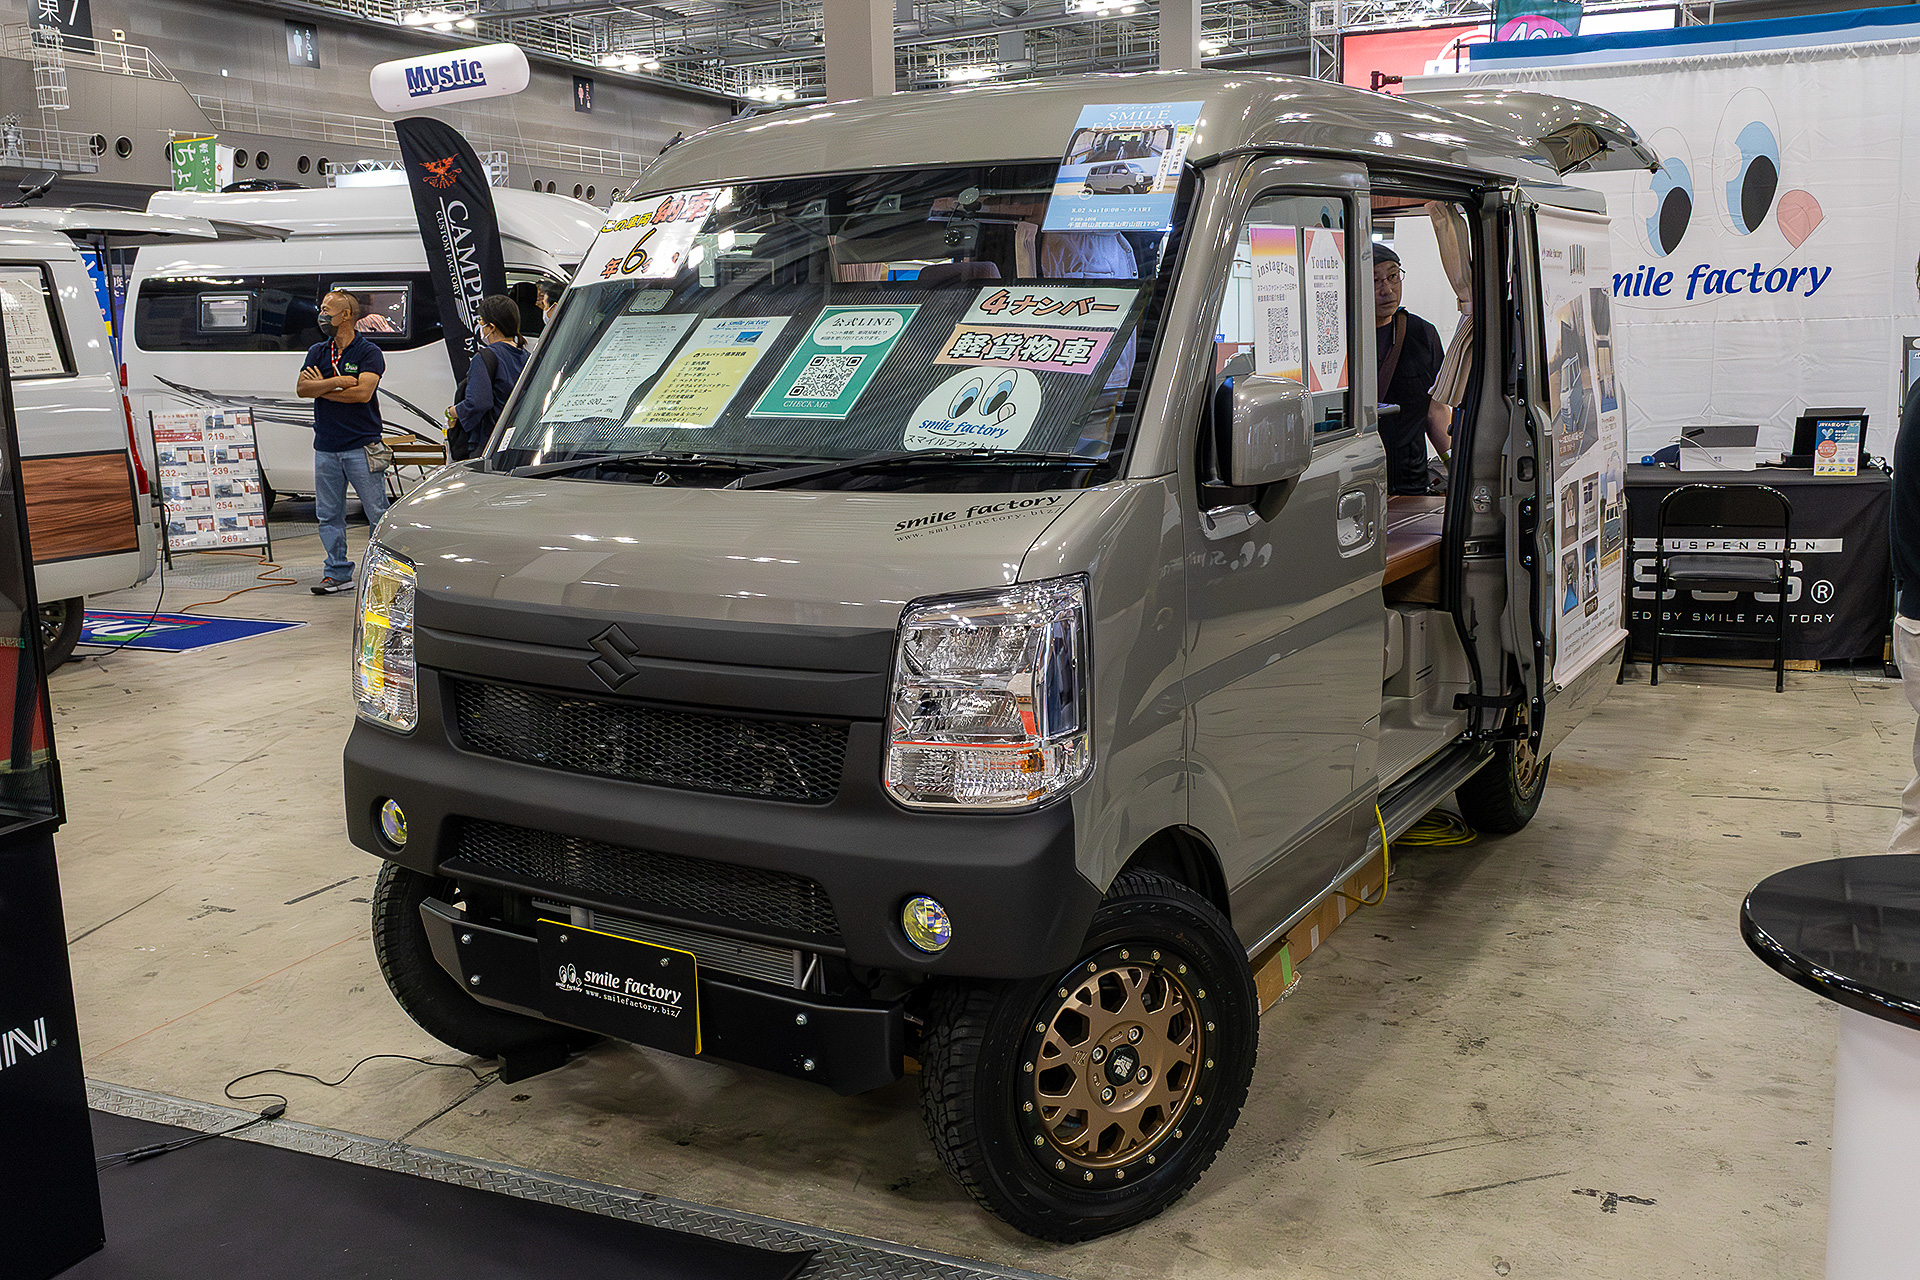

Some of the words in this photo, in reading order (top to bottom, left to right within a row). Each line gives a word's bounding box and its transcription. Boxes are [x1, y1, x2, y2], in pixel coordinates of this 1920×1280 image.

[405, 59, 486, 93] Mystic
[1091, 119, 1180, 132] FACTORY
[1107, 110, 1170, 121] SMILE
[435, 210, 450, 252] CUSTOM
[446, 253, 462, 296] FACTORY
[1311, 255, 1339, 270] Youtube
[1257, 260, 1295, 278] instagram
[1685, 262, 1832, 301] factory
[979, 289, 1120, 316] 4ナンバー
[832, 317, 896, 327] 公式LINE
[946, 331, 1098, 366] 軽貨物車
[783, 400, 813, 408] CHECK
[918, 419, 954, 431] smile
[953, 421, 1009, 439] factory
[894, 510, 957, 532] smile
[966, 495, 1062, 519] factory
[1662, 611, 1683, 621] BY
[1692, 612, 1745, 623] SMILE
[1755, 613, 1836, 624] FATORY
[584, 970, 620, 989] smile
[624, 978, 682, 1005] factory
